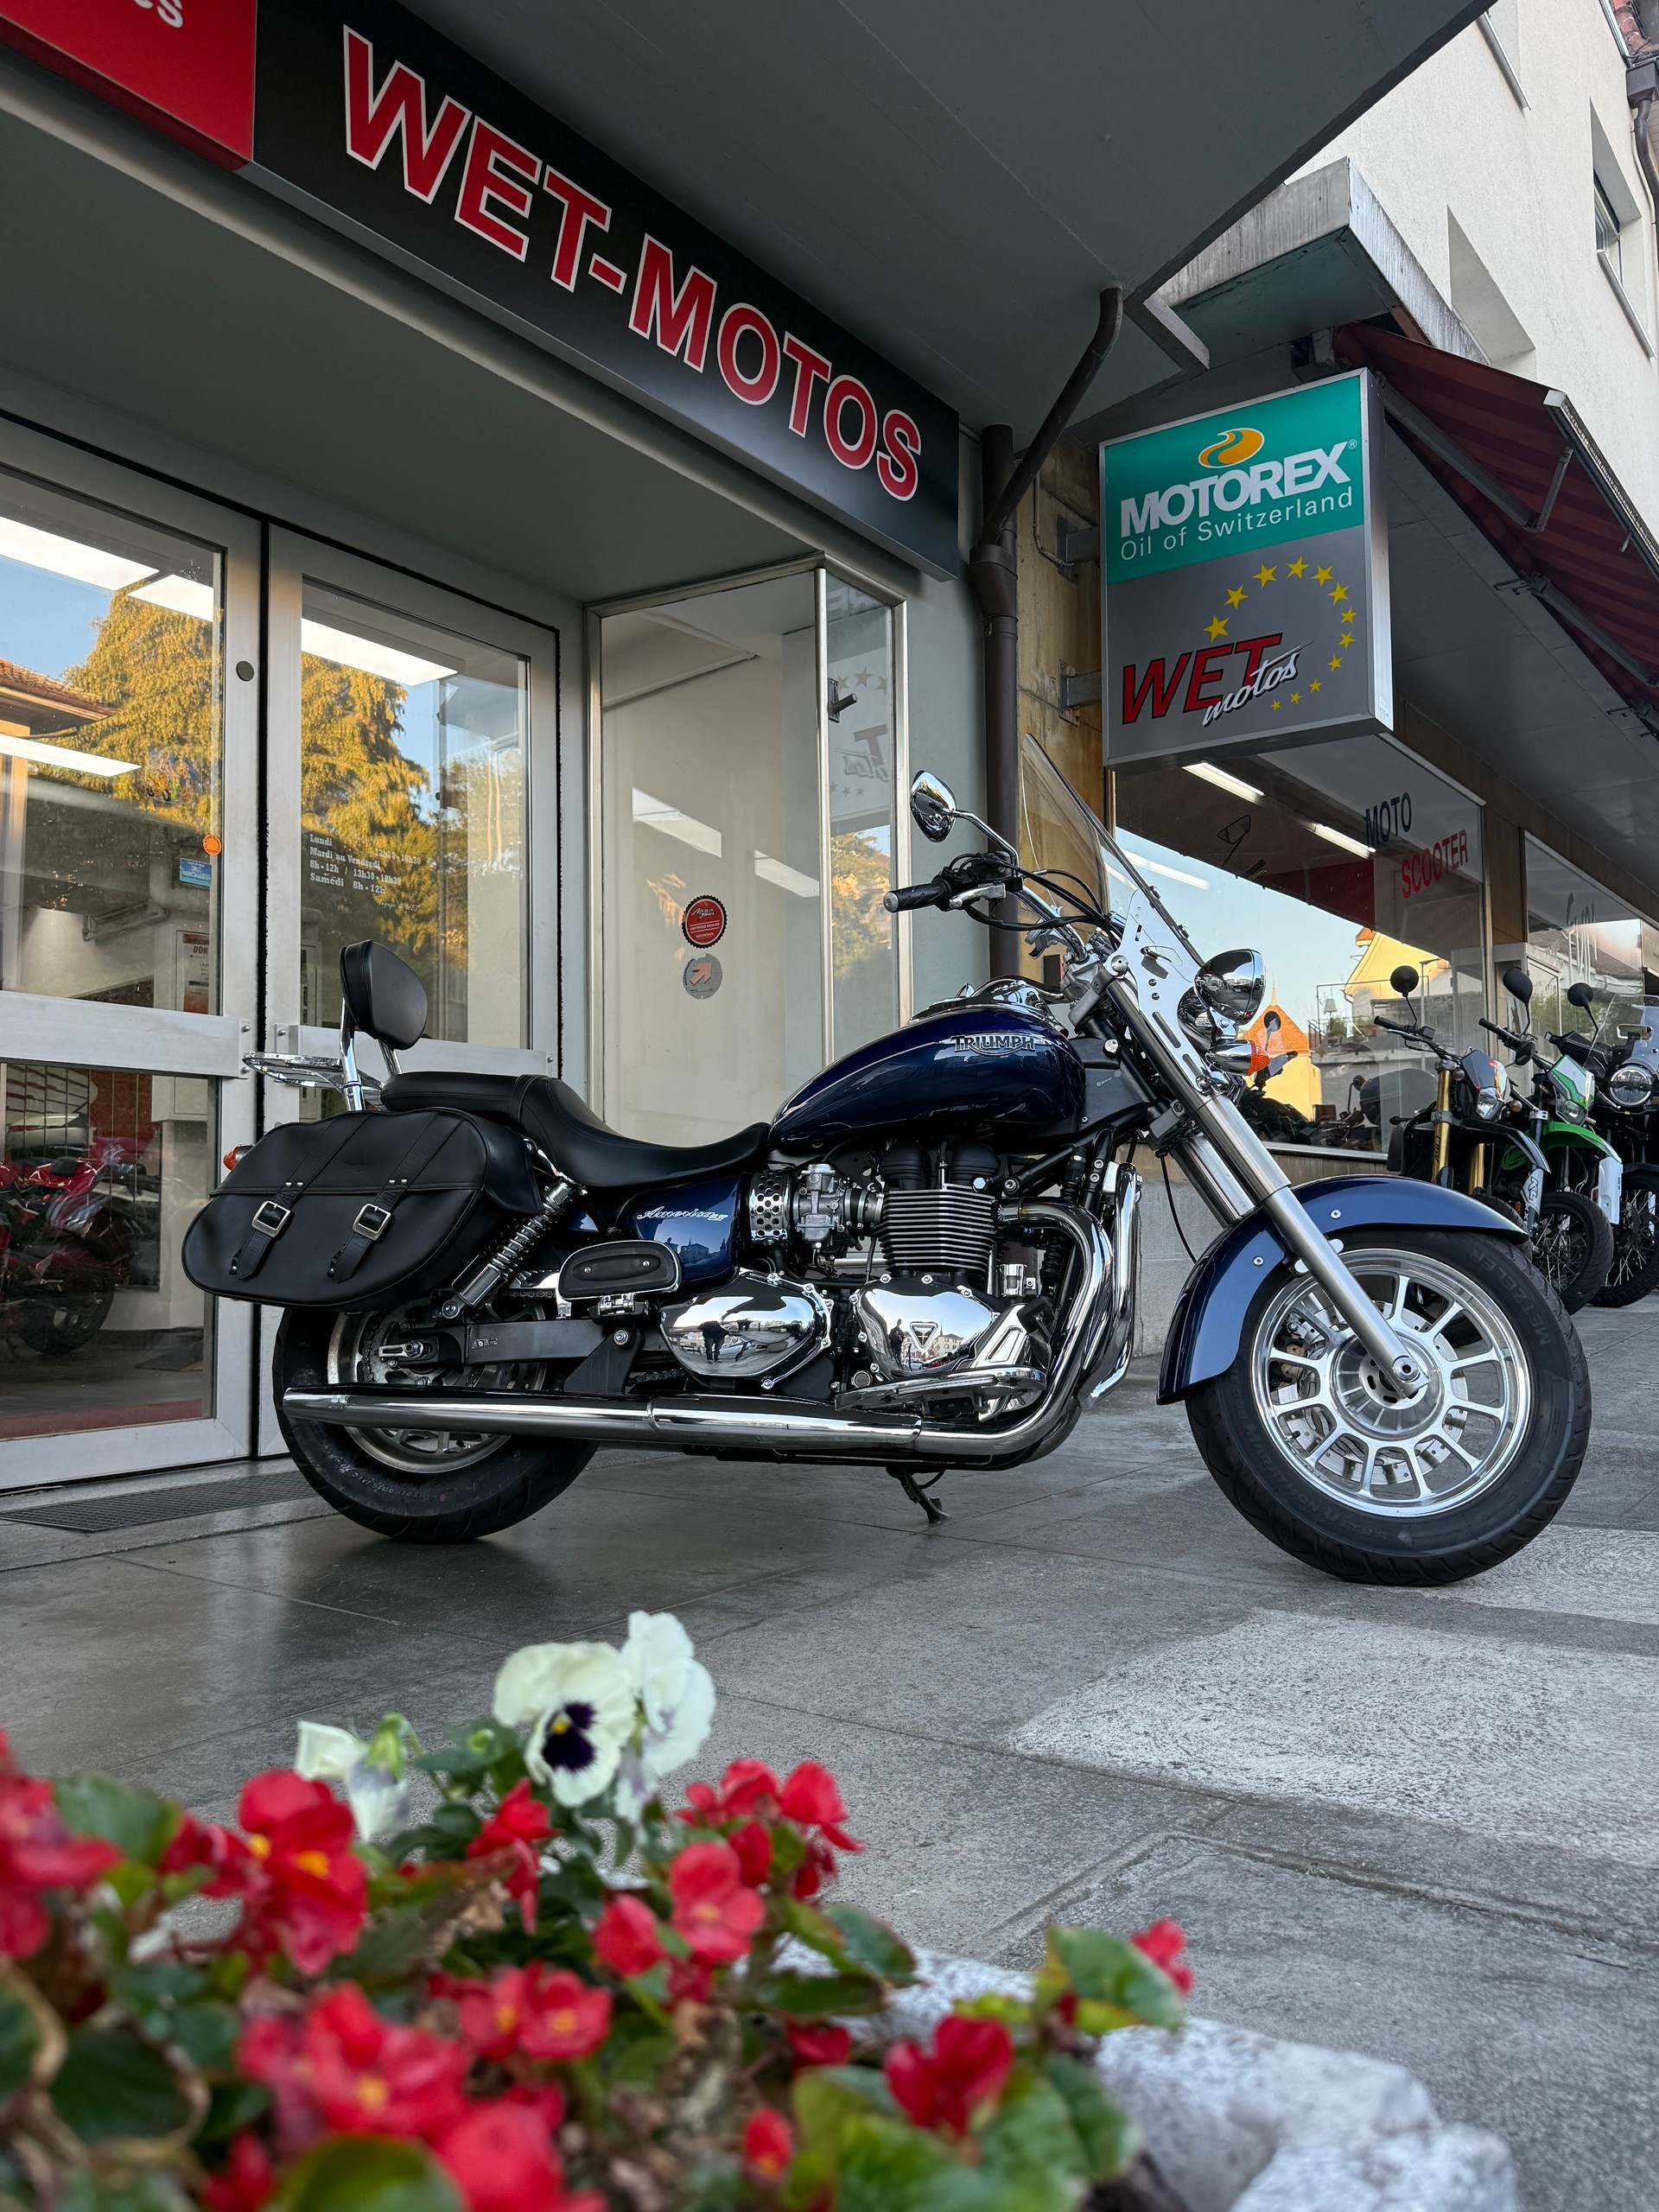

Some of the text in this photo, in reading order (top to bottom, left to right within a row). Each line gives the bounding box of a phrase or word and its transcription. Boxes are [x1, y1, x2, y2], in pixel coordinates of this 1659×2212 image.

[343, 24, 922, 502] WET-MOTOS
[1121, 441, 1351, 537] MOTOREX
[1121, 486, 1352, 561] Oil of Switzerland
[1122, 632, 1283, 725] WET
[1202, 641, 1314, 728] motos
[309, 834, 333, 847] Lundi
[1365, 792, 1412, 848] MOTO
[309, 847, 381, 869] Mardi au Vendredi
[309, 860, 320, 870] 8h
[326, 863, 340, 874] 12h
[353, 868, 375, 880] 13h30
[381, 874, 402, 886] 18h30
[310, 873, 345, 887] Samedi
[353, 880, 364, 892] 8h
[371, 884, 385, 895] 12h
[1402, 830, 1468, 899] SCOOTER
[951, 1035, 1036, 1056] TRIUMPH
[1470, 1249, 1553, 1346] METZELER
